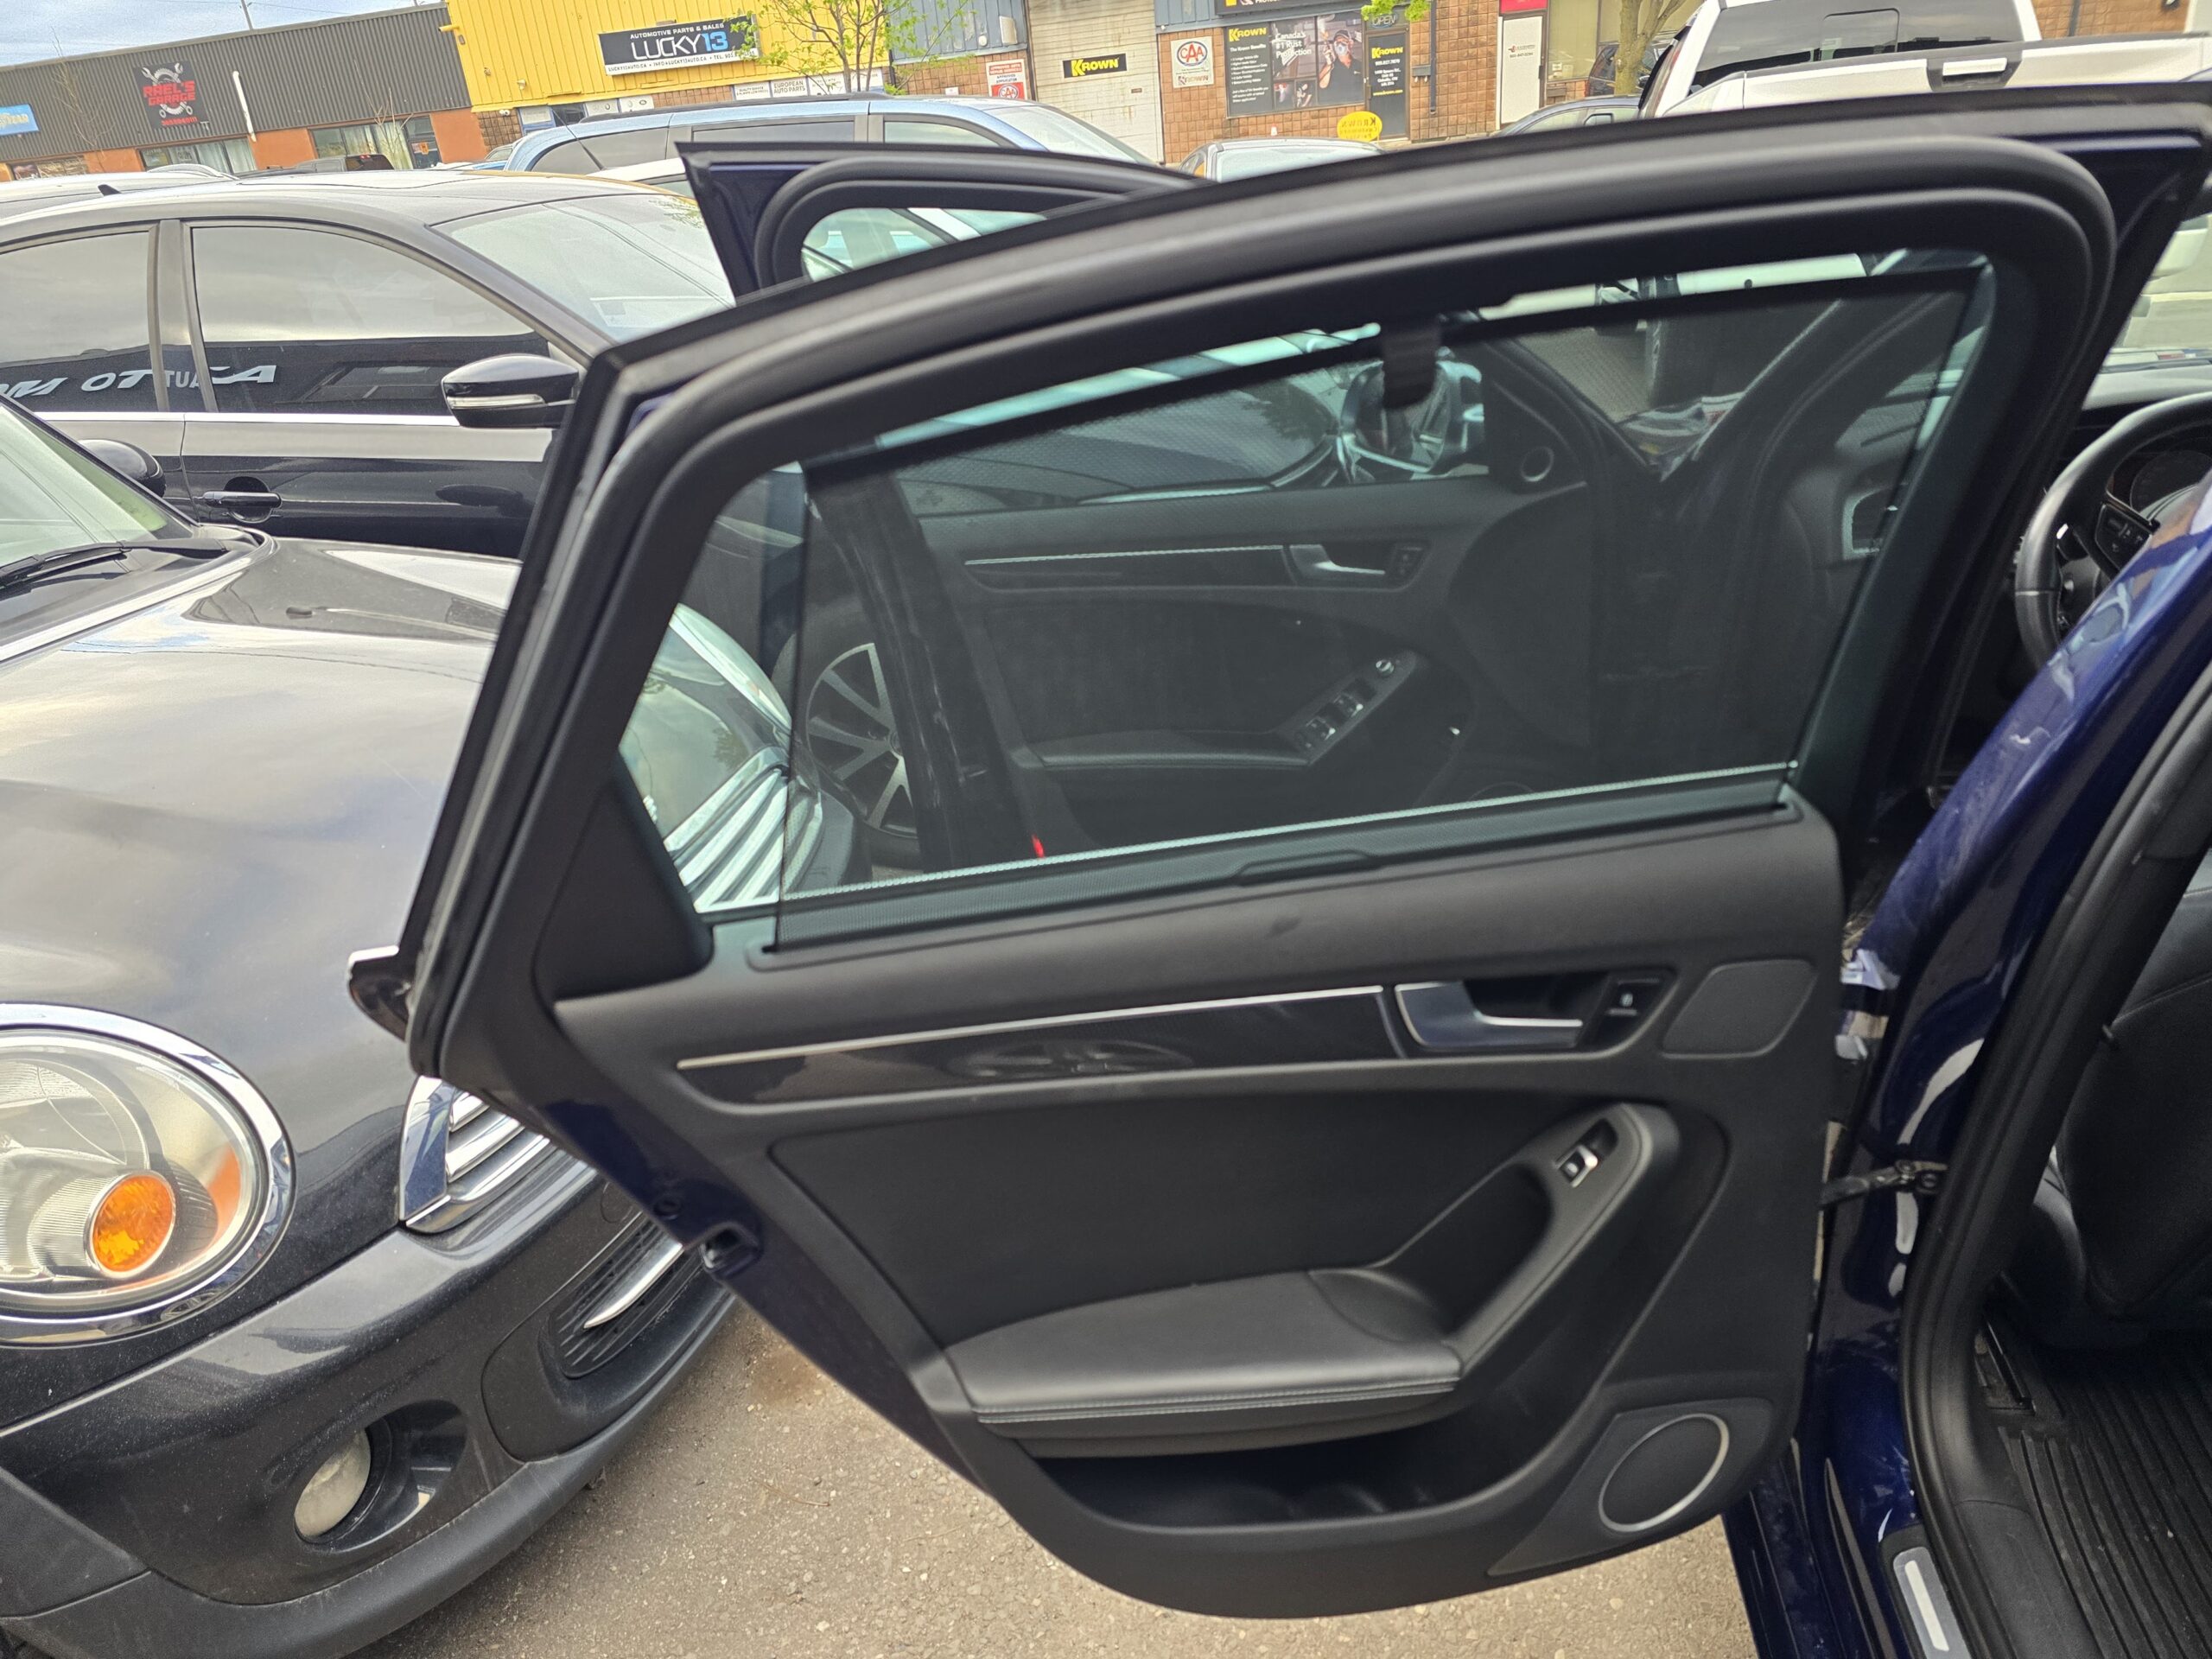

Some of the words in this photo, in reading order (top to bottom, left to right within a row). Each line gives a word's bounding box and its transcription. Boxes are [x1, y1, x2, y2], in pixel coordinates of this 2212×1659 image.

[1372, 15, 1395, 25] OPEN
[630, 29, 671, 40] AUTOMOTIVE
[1229, 28, 1267, 41] KROWN
[631, 31, 728, 60] LUCKY13
[1180, 44, 1204, 62] CAA
[1371, 47, 1404, 59] KROWN
[1071, 57, 1119, 77] KROWN
[143, 80, 195, 98] RAEL'S
[773, 79, 804, 88] EUROPEAN
[149, 92, 196, 106] GARAGE
